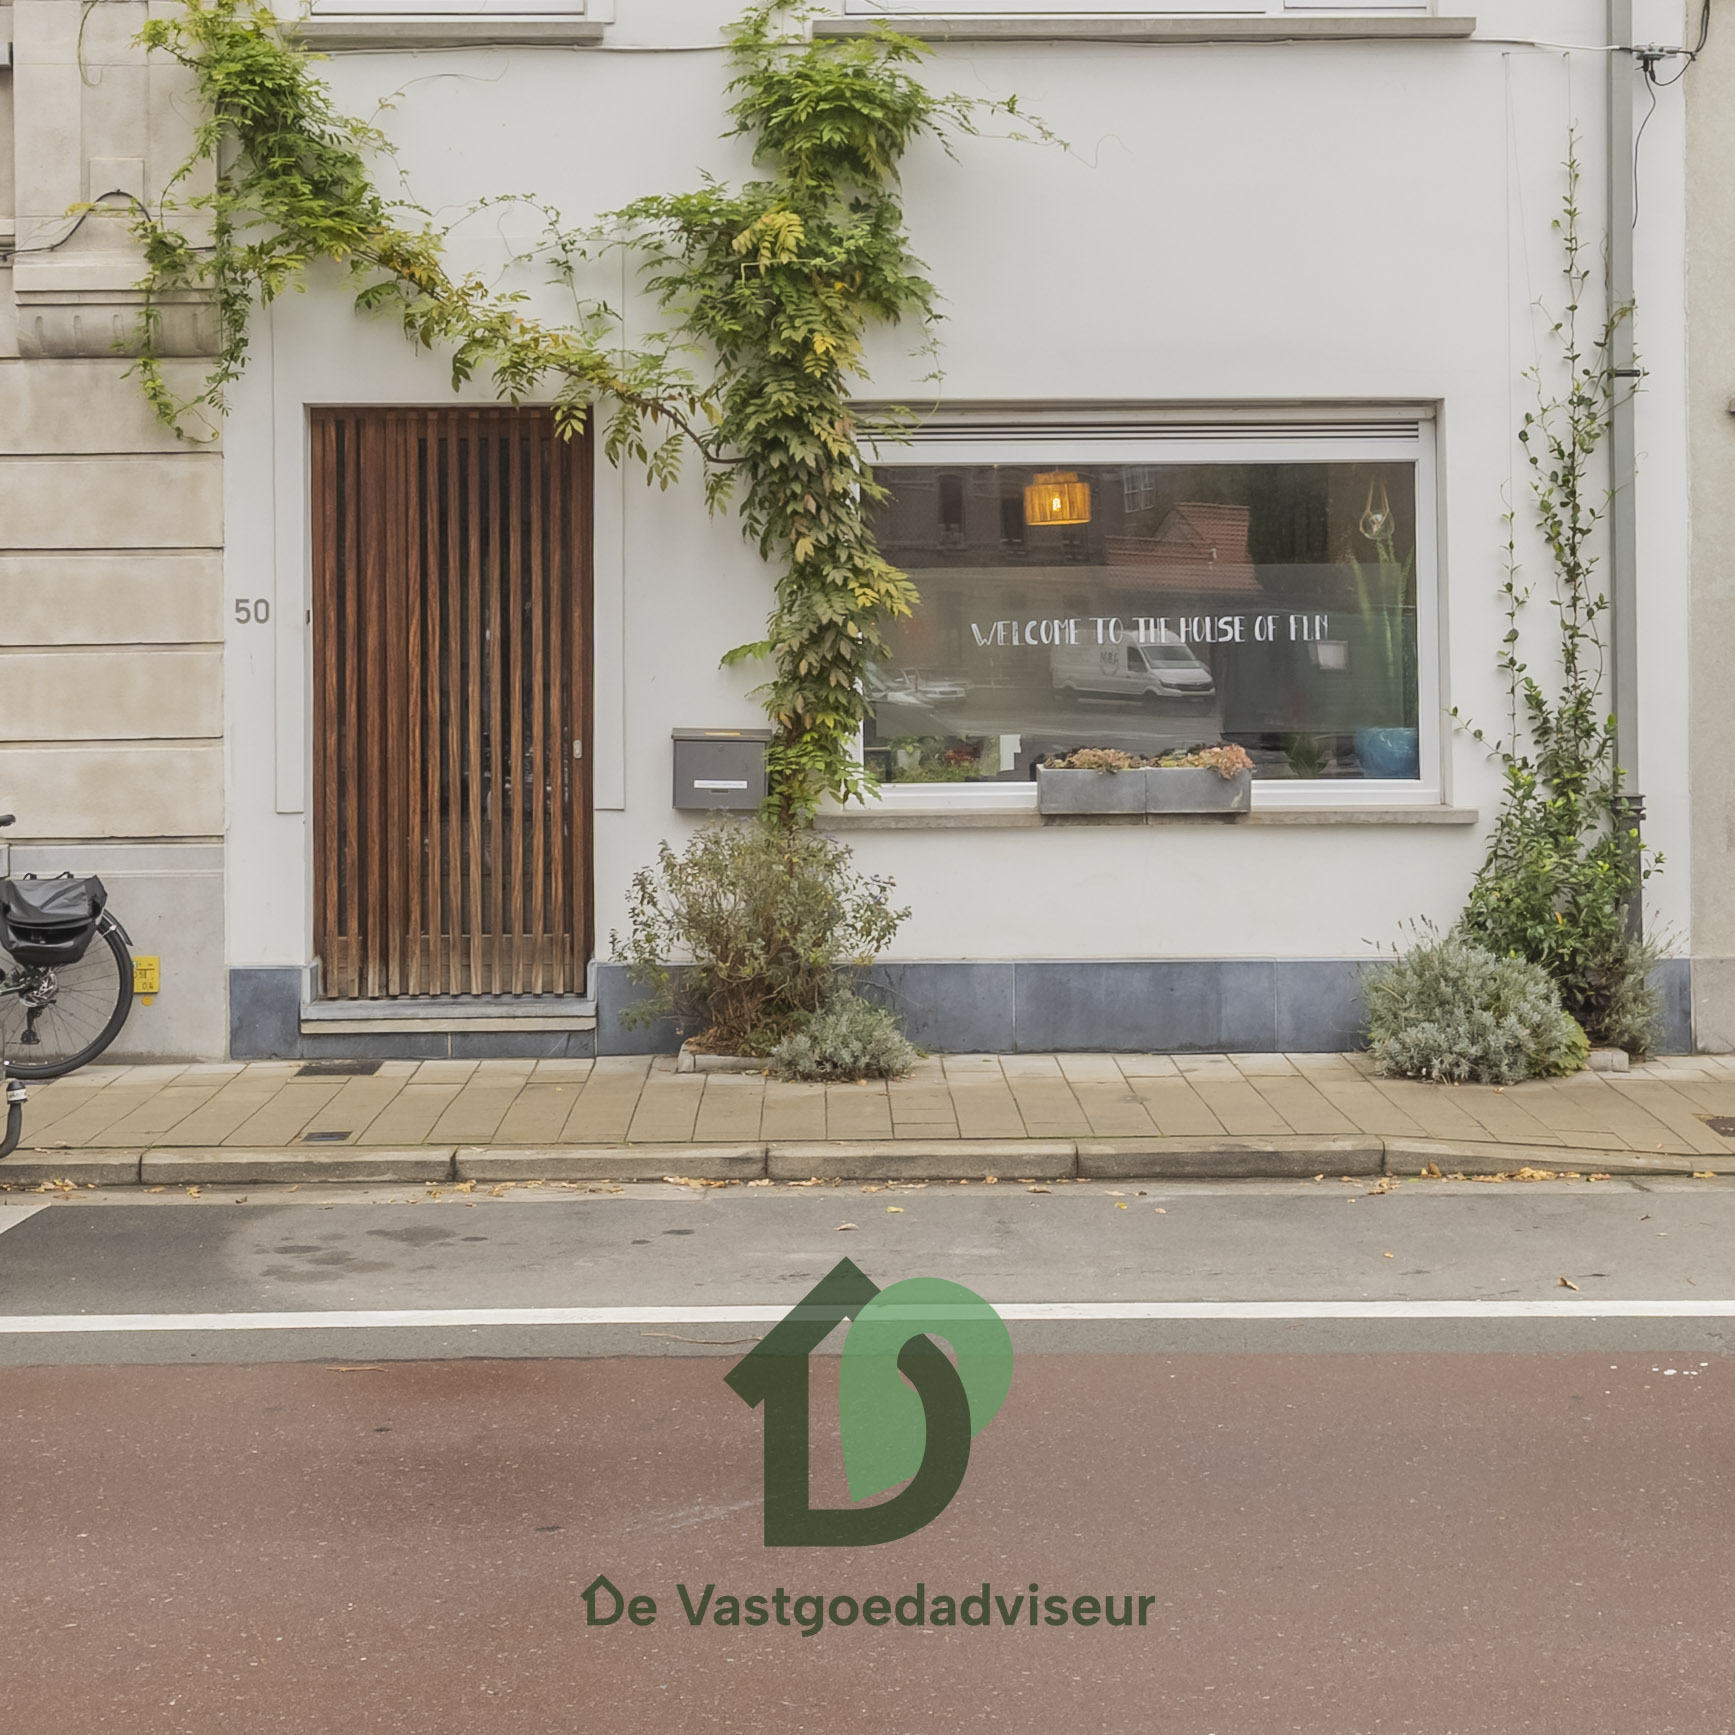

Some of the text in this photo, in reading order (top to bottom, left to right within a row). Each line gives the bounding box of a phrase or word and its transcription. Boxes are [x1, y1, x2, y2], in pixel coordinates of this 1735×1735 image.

[235, 598, 270, 625] 50
[970, 617, 1081, 647] WELCOME
[1089, 617, 1124, 645] TO
[1131, 616, 1171, 644] THE
[1179, 615, 1246, 643] HOUSE
[1254, 614, 1280, 642] OF
